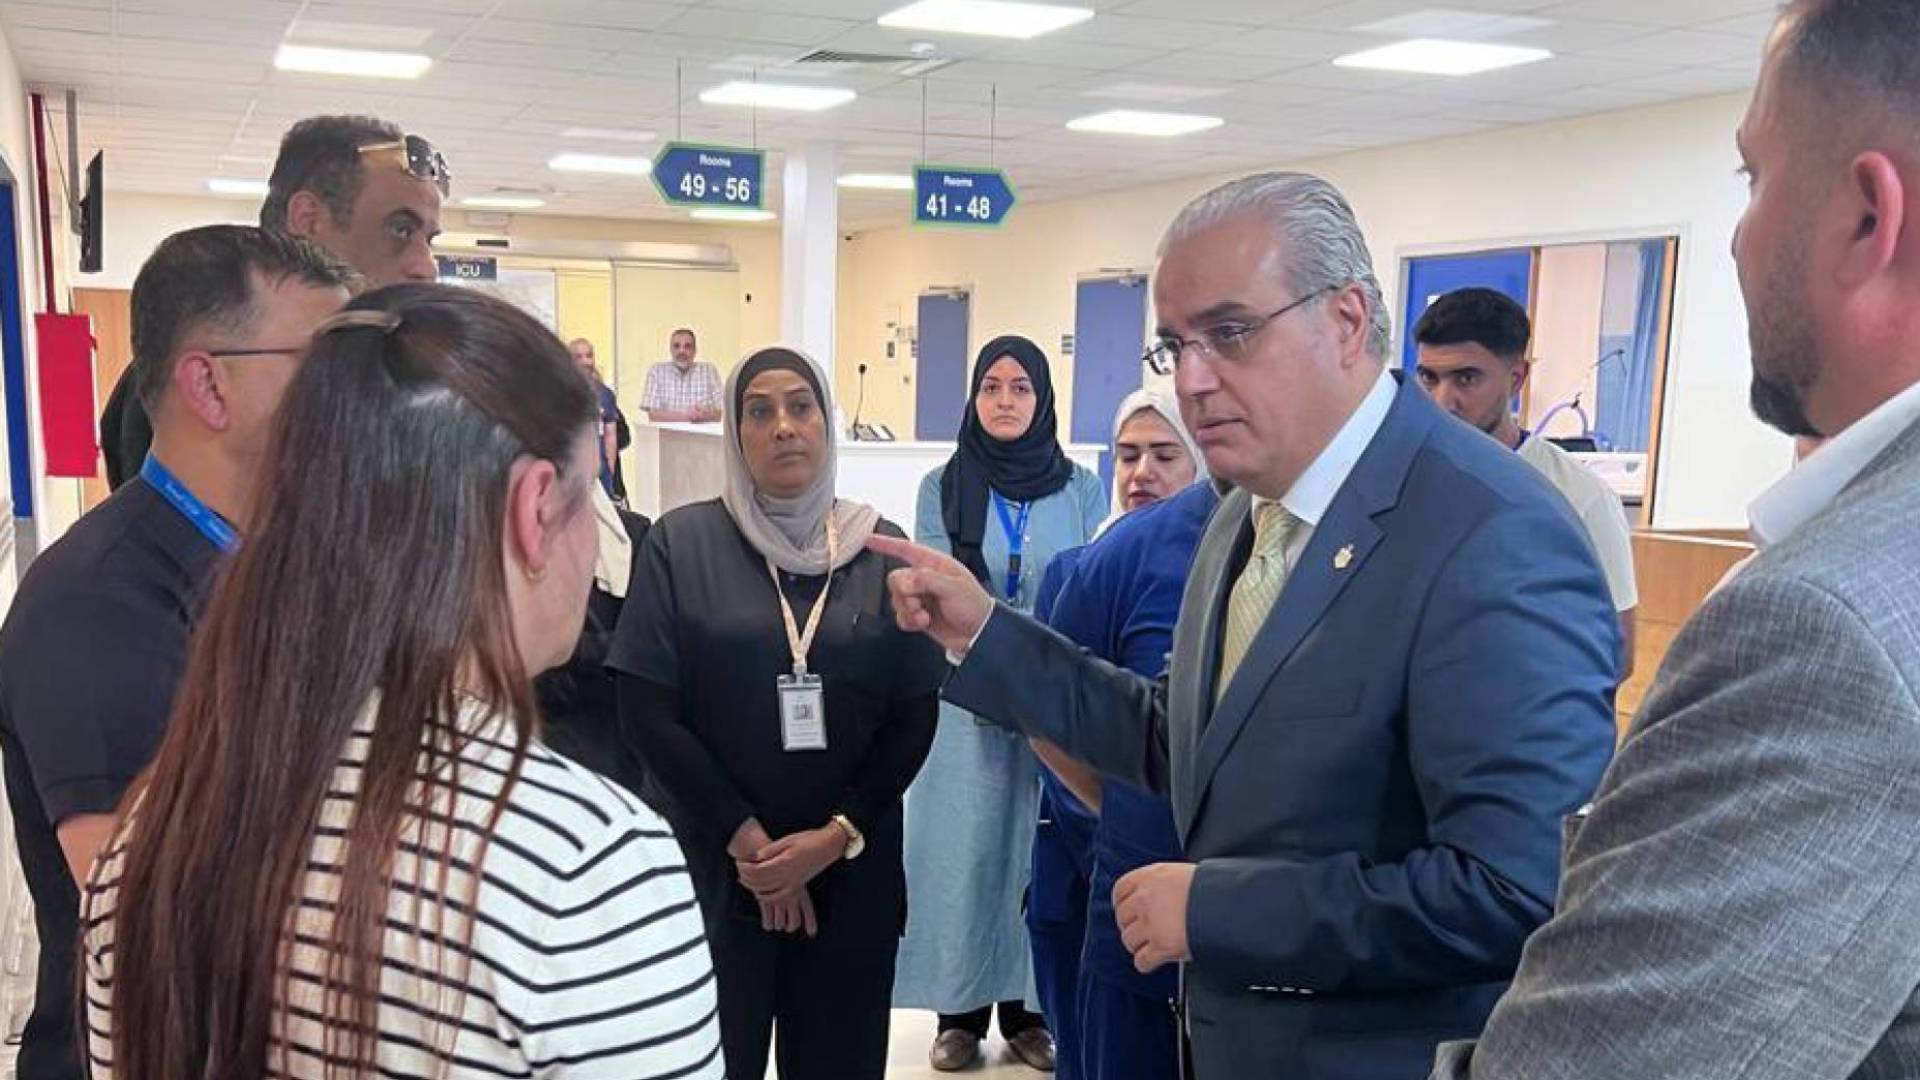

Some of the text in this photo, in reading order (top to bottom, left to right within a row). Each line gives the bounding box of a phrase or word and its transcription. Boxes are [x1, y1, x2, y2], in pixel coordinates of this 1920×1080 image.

[700, 154, 731, 167] Rooms
[680, 172, 705, 198] 49
[725, 177, 750, 202] 56
[943, 175, 973, 187] Rooms
[926, 192, 948, 217] 41
[967, 195, 990, 219] 48
[455, 263, 481, 277] ICU
